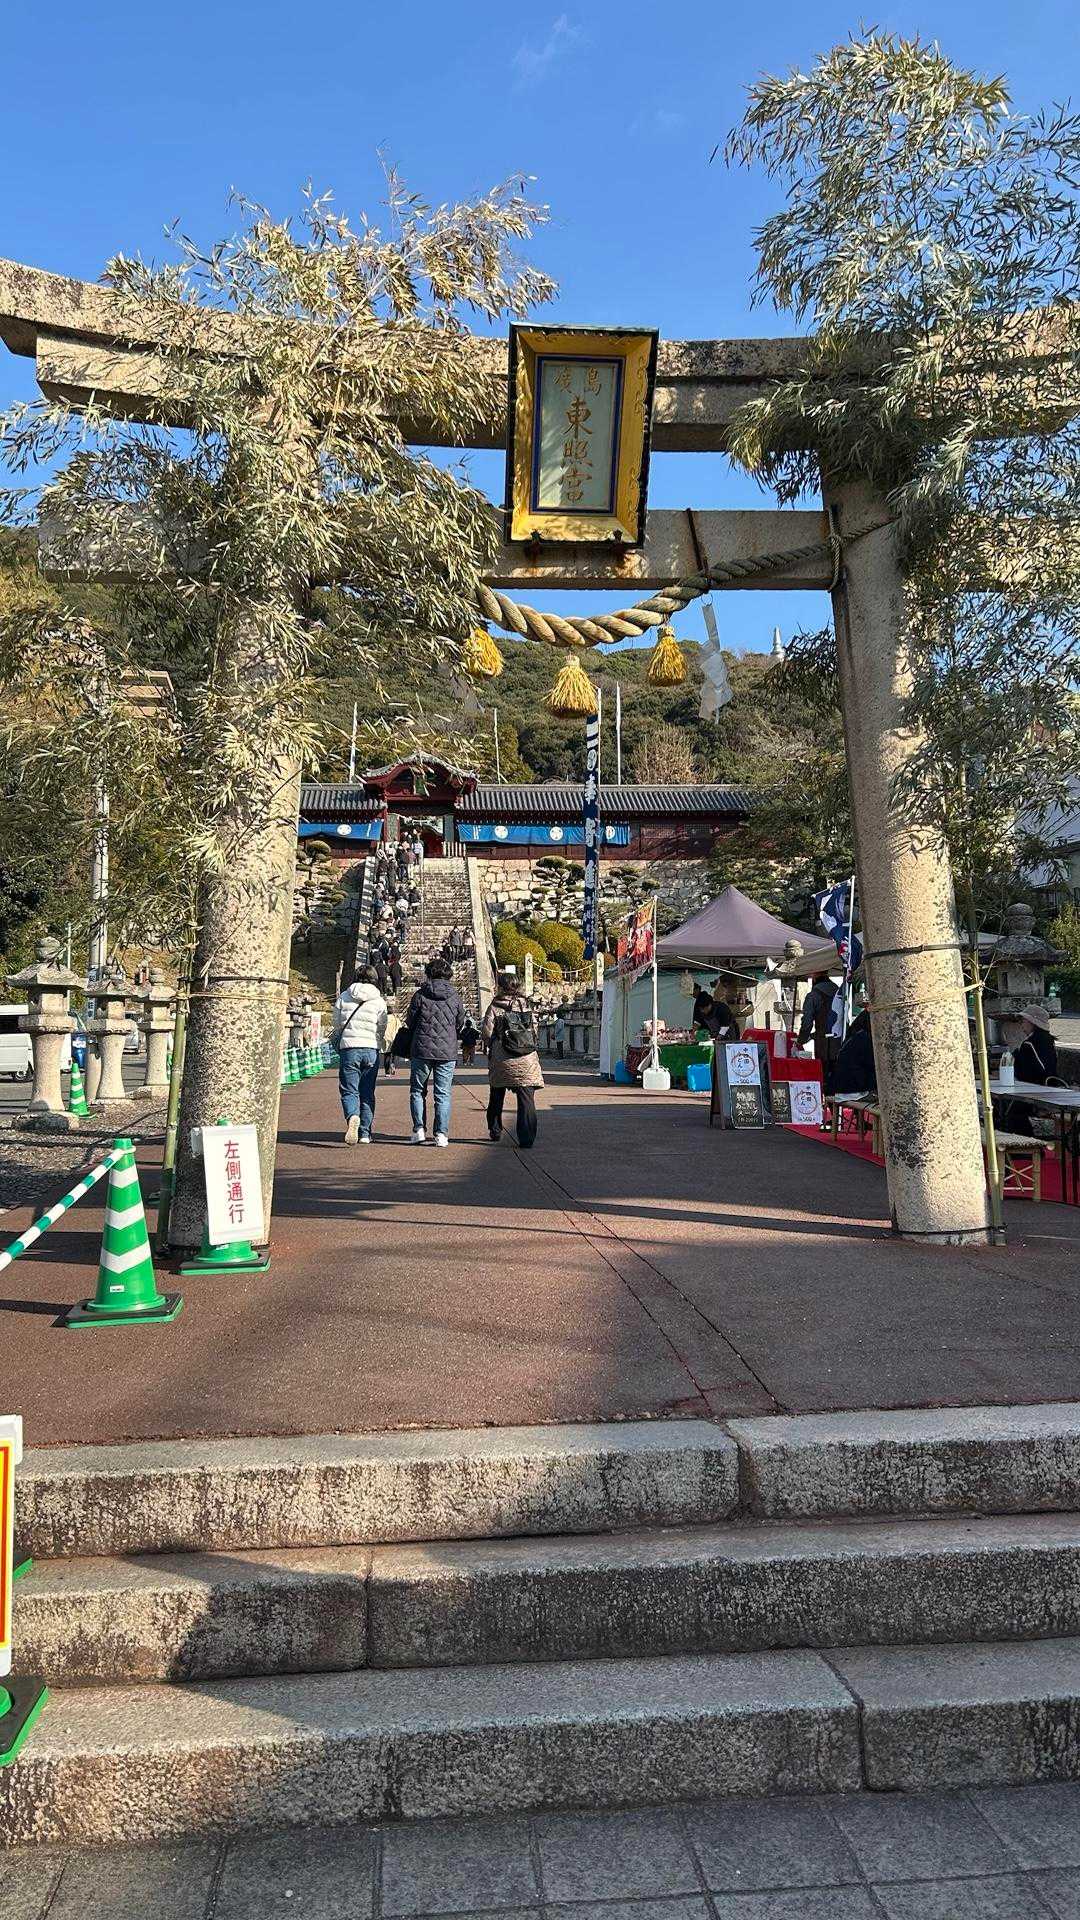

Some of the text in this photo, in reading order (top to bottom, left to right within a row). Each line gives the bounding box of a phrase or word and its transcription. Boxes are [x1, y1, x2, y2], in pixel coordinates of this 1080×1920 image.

[558, 395, 593, 503] 東照宮
[224, 1139, 245, 1225] 左側通行
